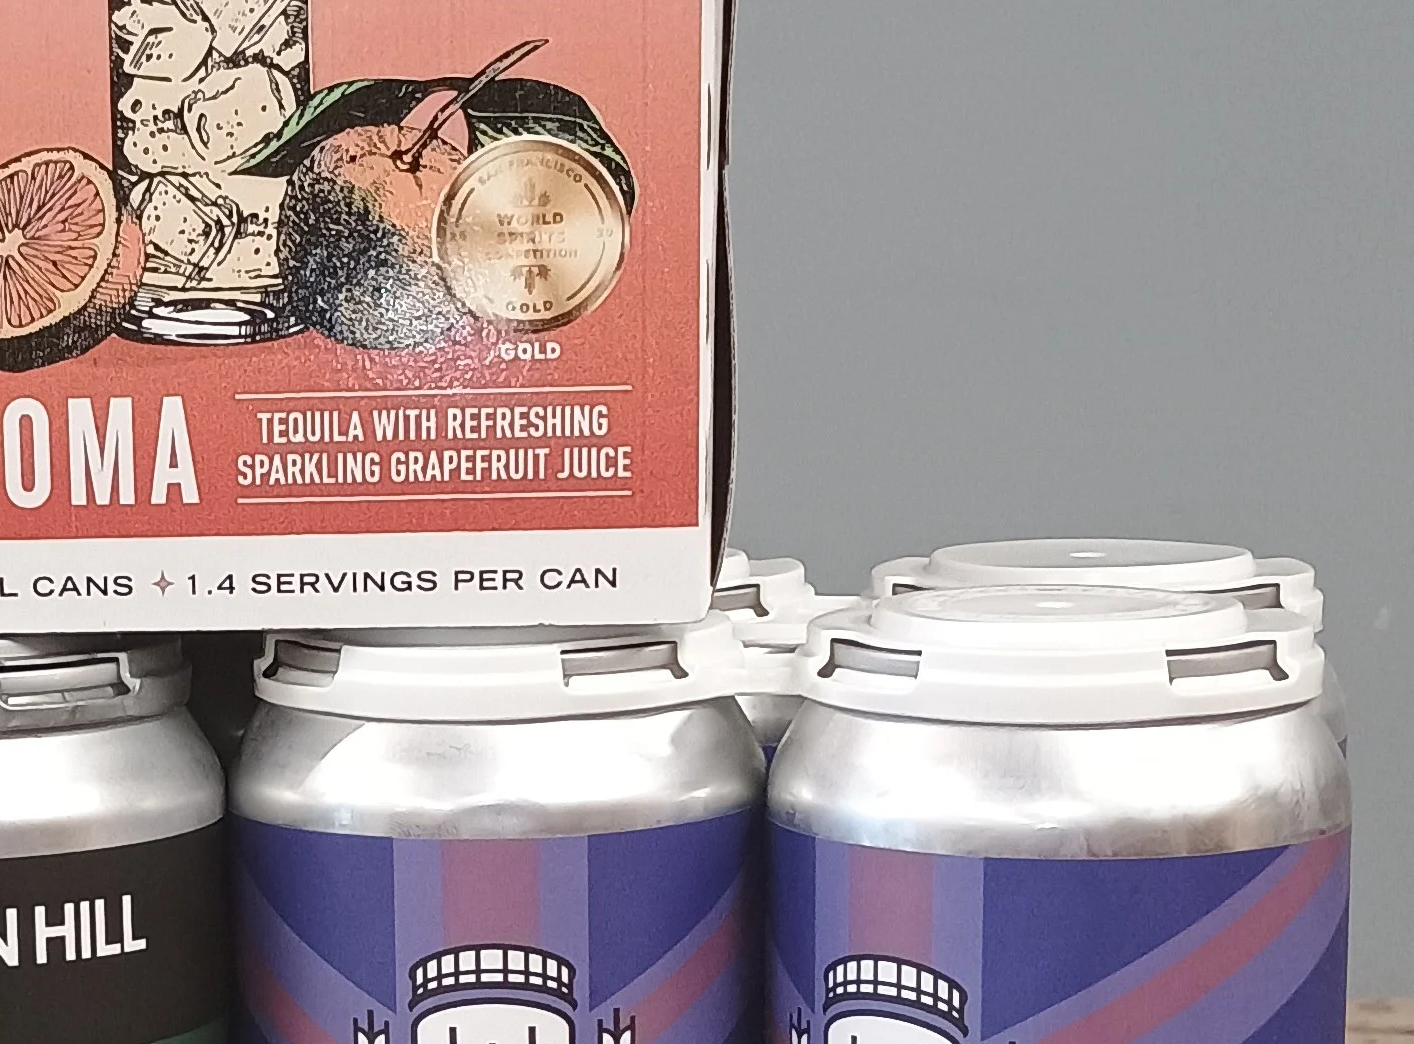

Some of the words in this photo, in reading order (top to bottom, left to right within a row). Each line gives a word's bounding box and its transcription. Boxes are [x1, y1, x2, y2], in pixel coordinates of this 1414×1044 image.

[496, 212, 564, 227] WORLD
[506, 301, 554, 314] GOLD
[499, 342, 561, 360] GOLD
[257, 410, 366, 446] TEQUILA
[372, 408, 438, 441] WITH
[445, 404, 609, 439] REFRESHING
[236, 451, 382, 487] SPARKLING
[389, 449, 550, 483] GRAPEFRUIT
[556, 446, 632, 480] JUICE
[29, 574, 135, 598] CANS
[186, 571, 238, 597] 1.4
[249, 569, 440, 595] SERVINGS
[452, 568, 526, 592] PER
[539, 565, 621, 590] CAN
[35, 894, 146, 964] HILL
